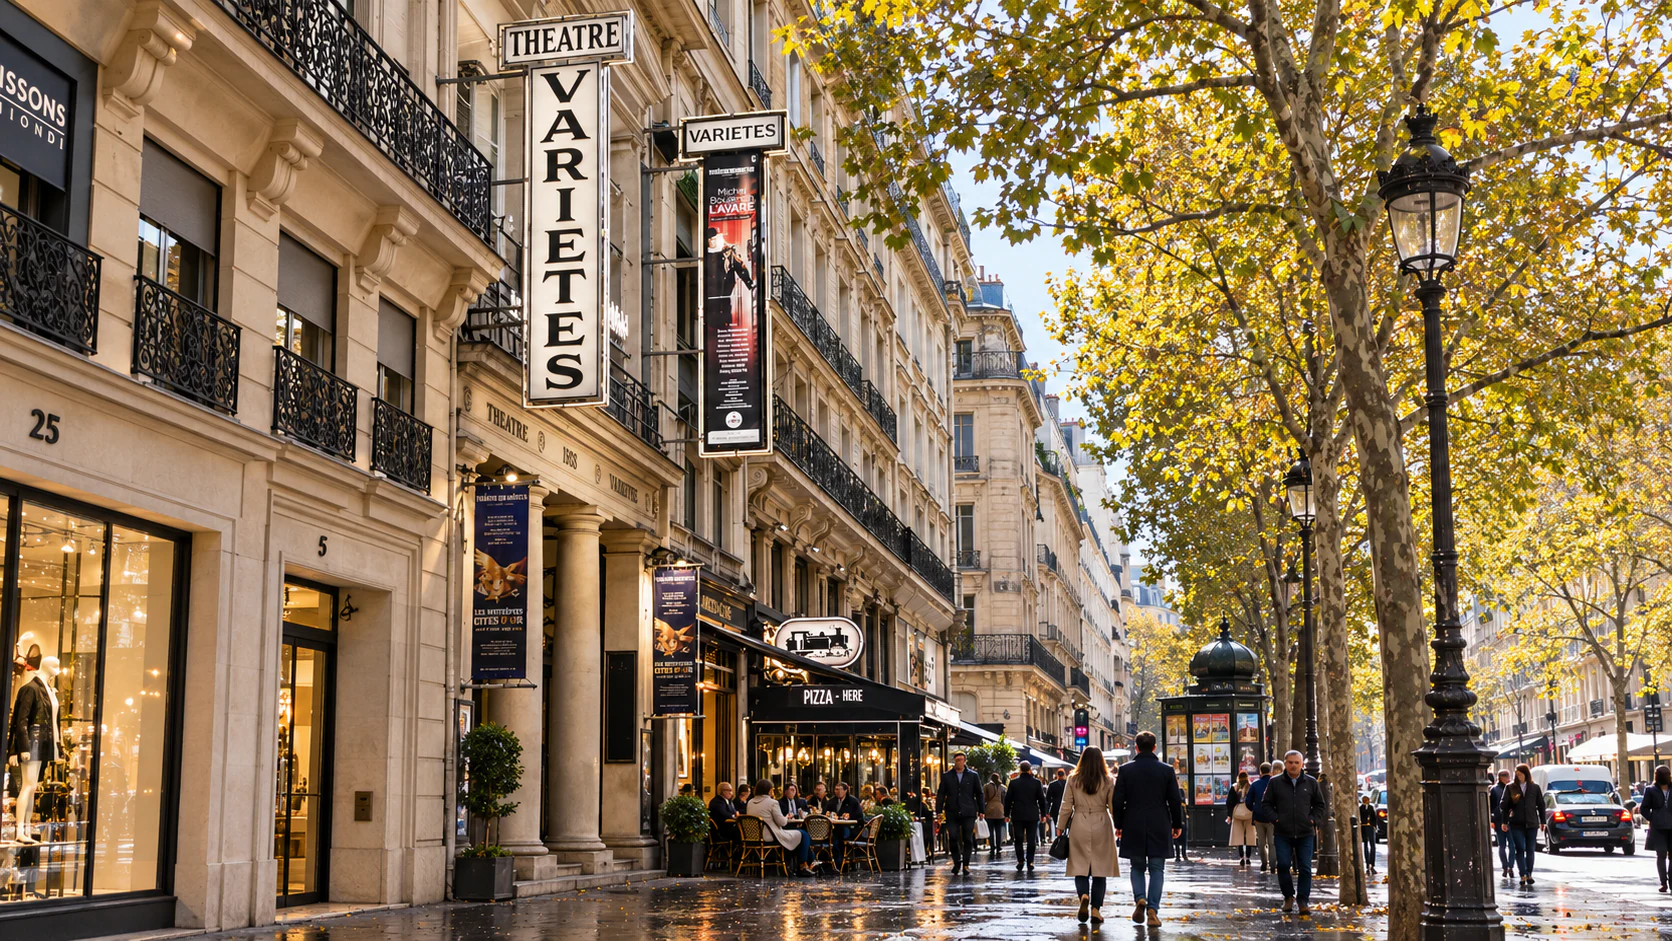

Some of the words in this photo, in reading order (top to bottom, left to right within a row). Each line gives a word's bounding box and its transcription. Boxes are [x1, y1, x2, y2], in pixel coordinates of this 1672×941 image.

[510, 21, 619, 56] THEATRE
[689, 124, 776, 143] VARIETES
[540, 69, 591, 390] VARIETES
[29, 409, 60, 444] 25
[487, 402, 528, 443] THEATRE
[318, 535, 328, 557] 5
[803, 690, 834, 705] PIZZA
[842, 689, 863, 702] HERE
